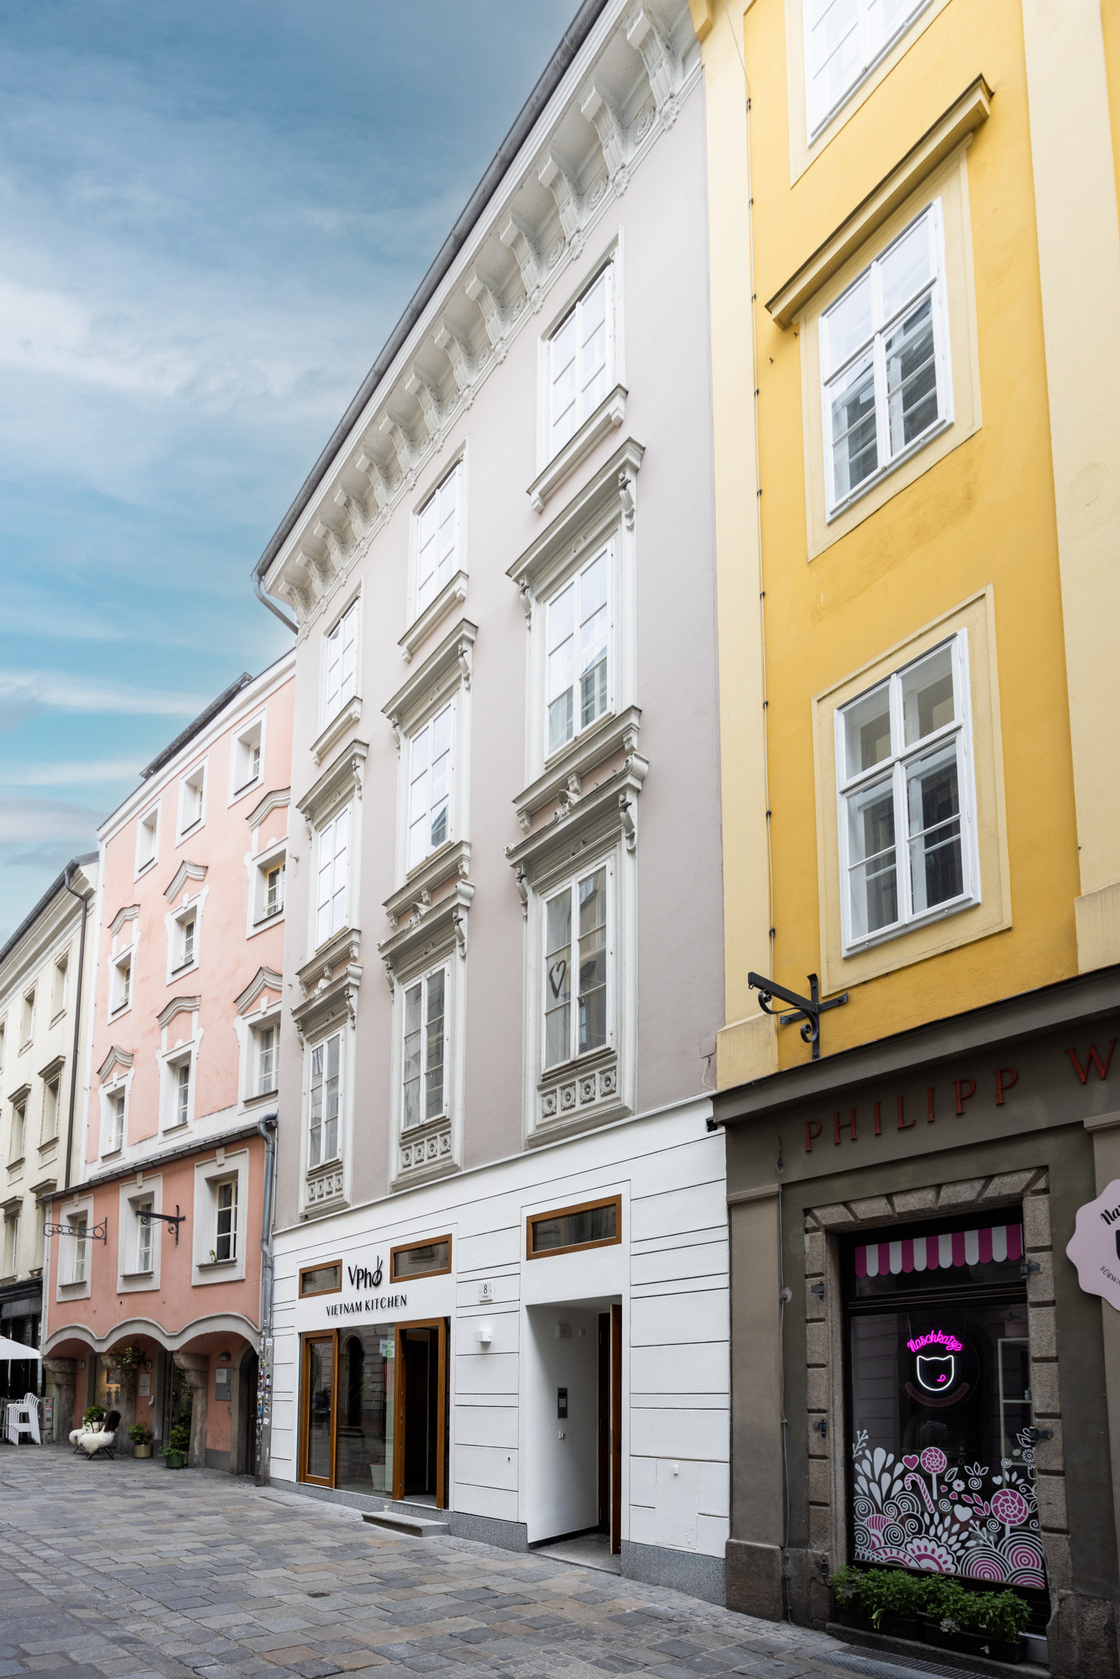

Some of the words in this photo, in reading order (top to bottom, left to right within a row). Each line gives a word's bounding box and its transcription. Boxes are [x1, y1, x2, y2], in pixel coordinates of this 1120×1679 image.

[805, 1067, 1018, 1152] PHILIPP
[1100, 1204, 1120, 1226] Na
[483, 1284, 488, 1294] 8
[326, 1301, 362, 1316] VIETNAM
[365, 1294, 407, 1311] KITCHEN
[907, 1330, 963, 1352] Naschkatze
